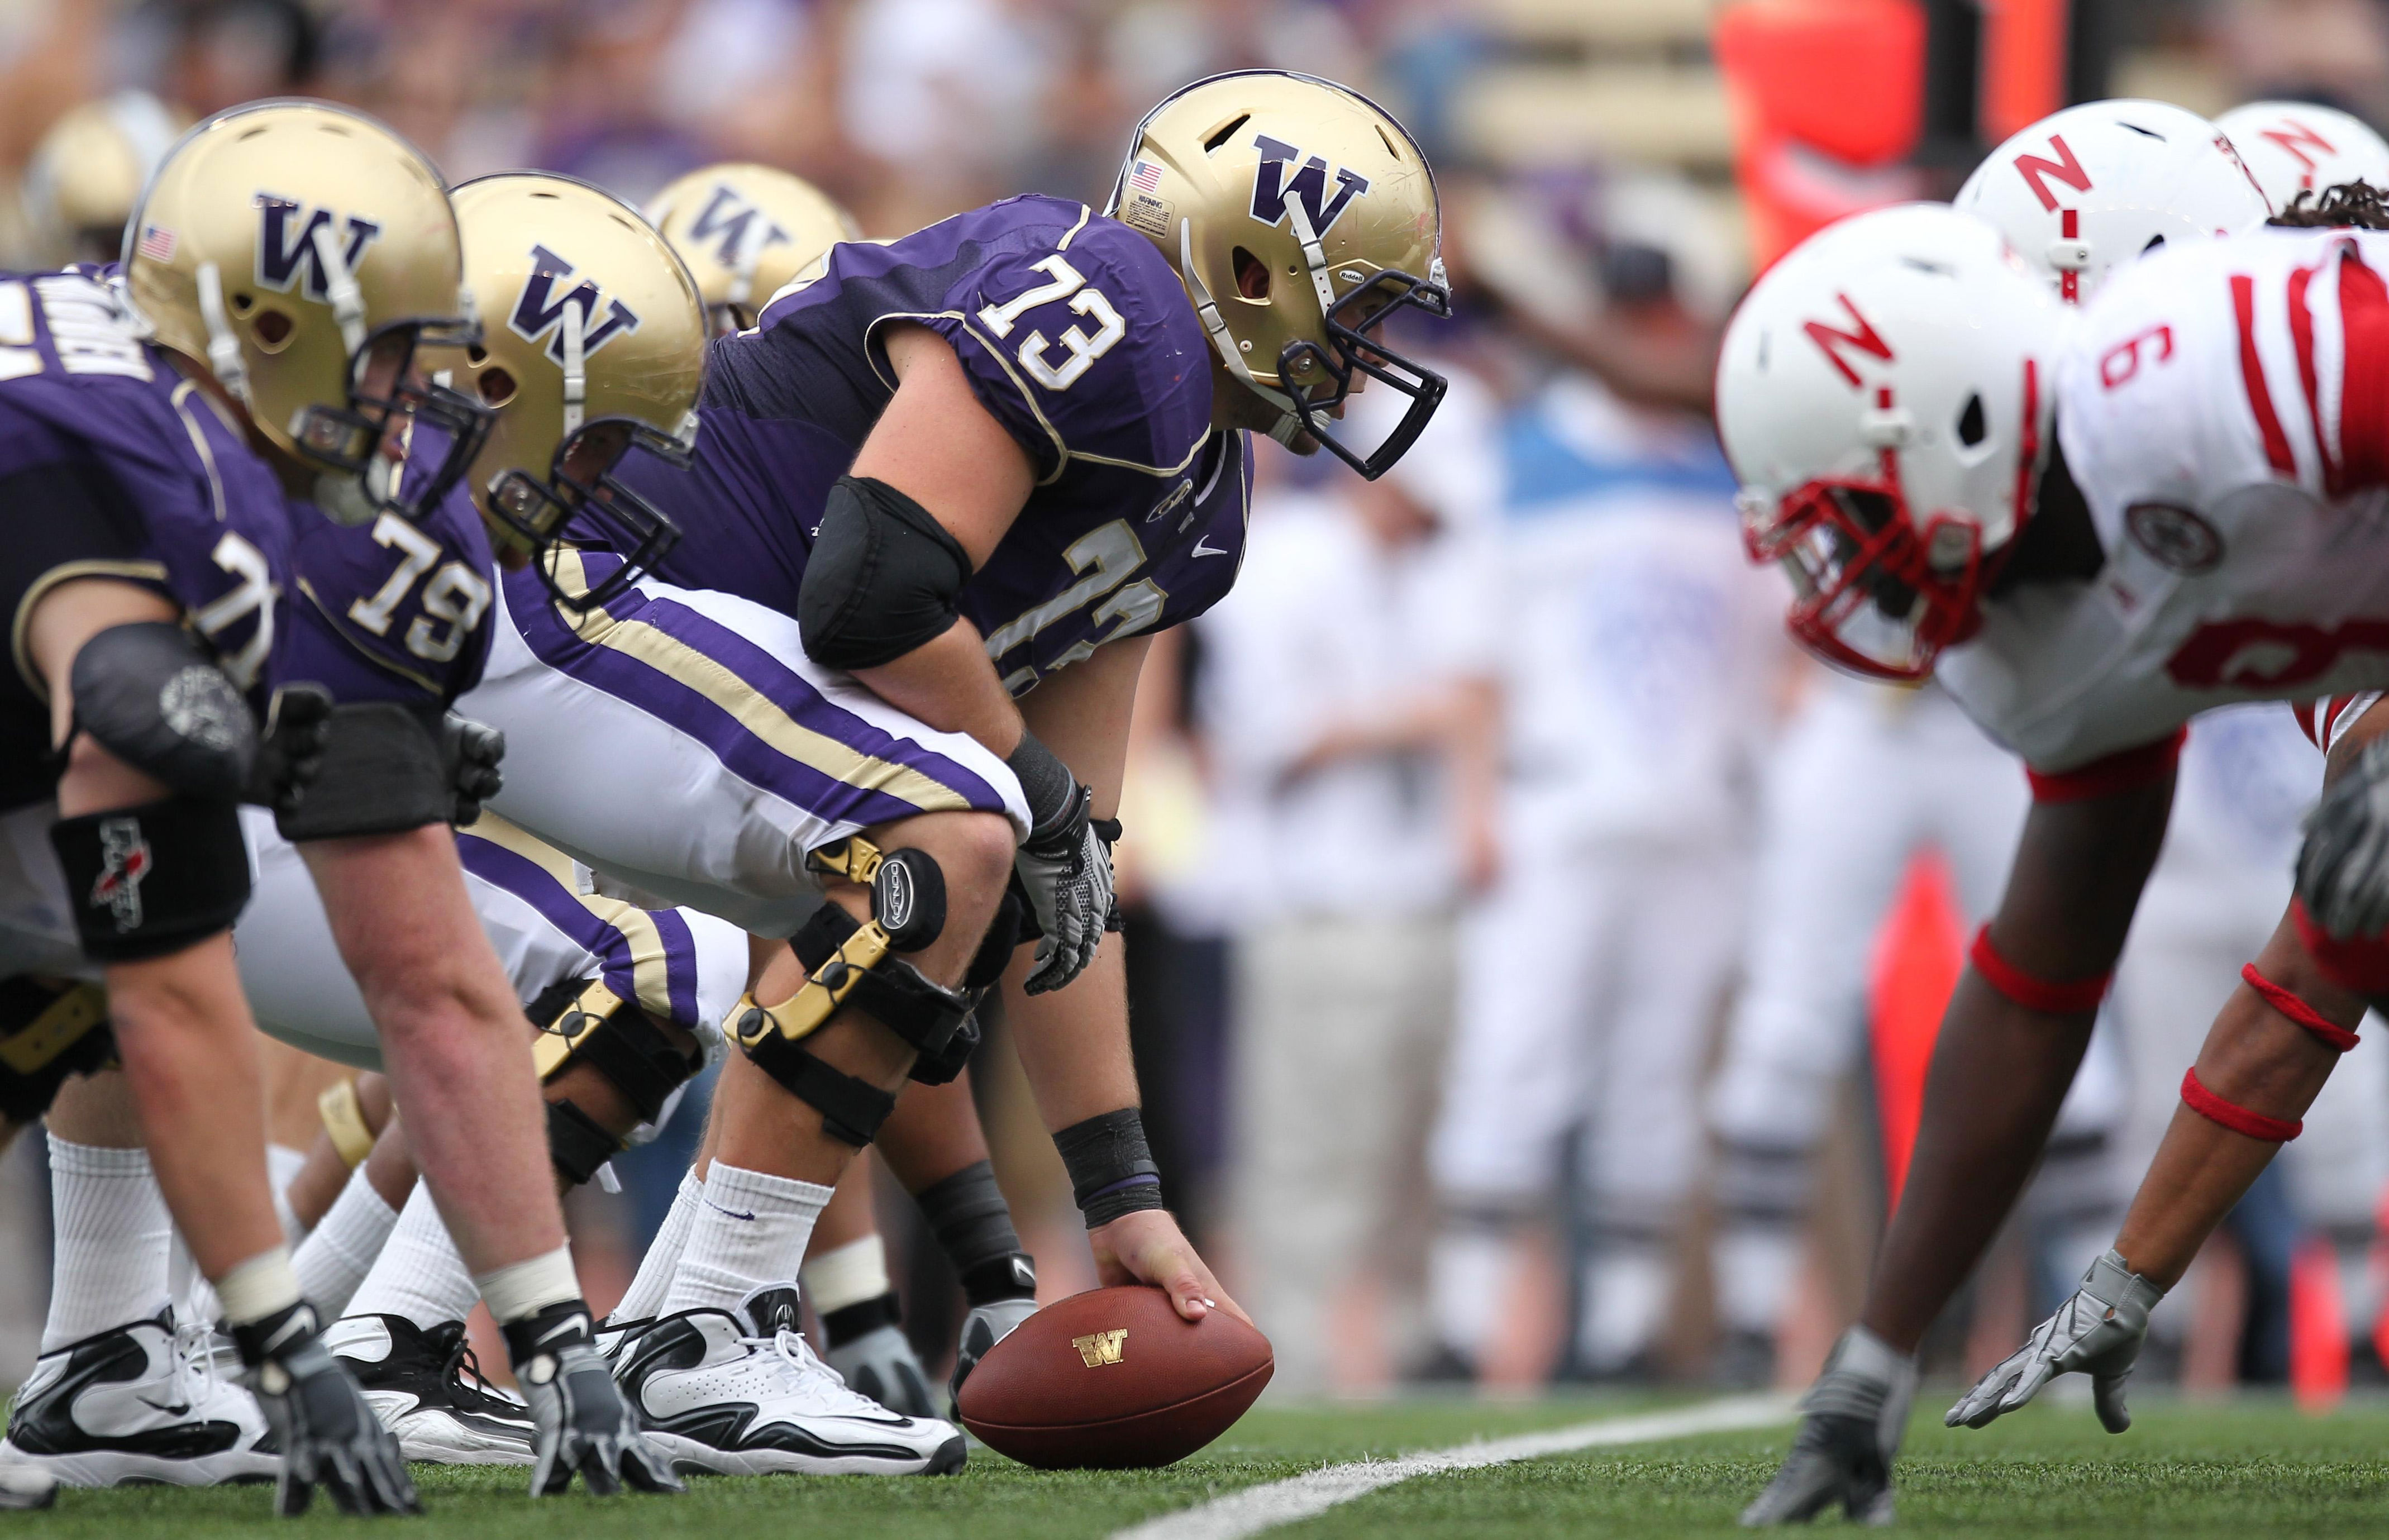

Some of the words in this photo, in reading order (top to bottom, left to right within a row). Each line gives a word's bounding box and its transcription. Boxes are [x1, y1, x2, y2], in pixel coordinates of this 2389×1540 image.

[1138, 194, 1163, 209] WARNING
[1250, 132, 1371, 239] W
[2013, 134, 2093, 213] N
[250, 191, 381, 305] W
[688, 183, 793, 268] W
[506, 242, 642, 369] W
[1341, 272, 1363, 282] Riddell
[976, 254, 1126, 392] 73
[1803, 292, 1895, 387] N
[347, 507, 494, 663] 79
[890, 864, 901, 925] DONJOY
[1071, 1328, 1129, 1368] W
